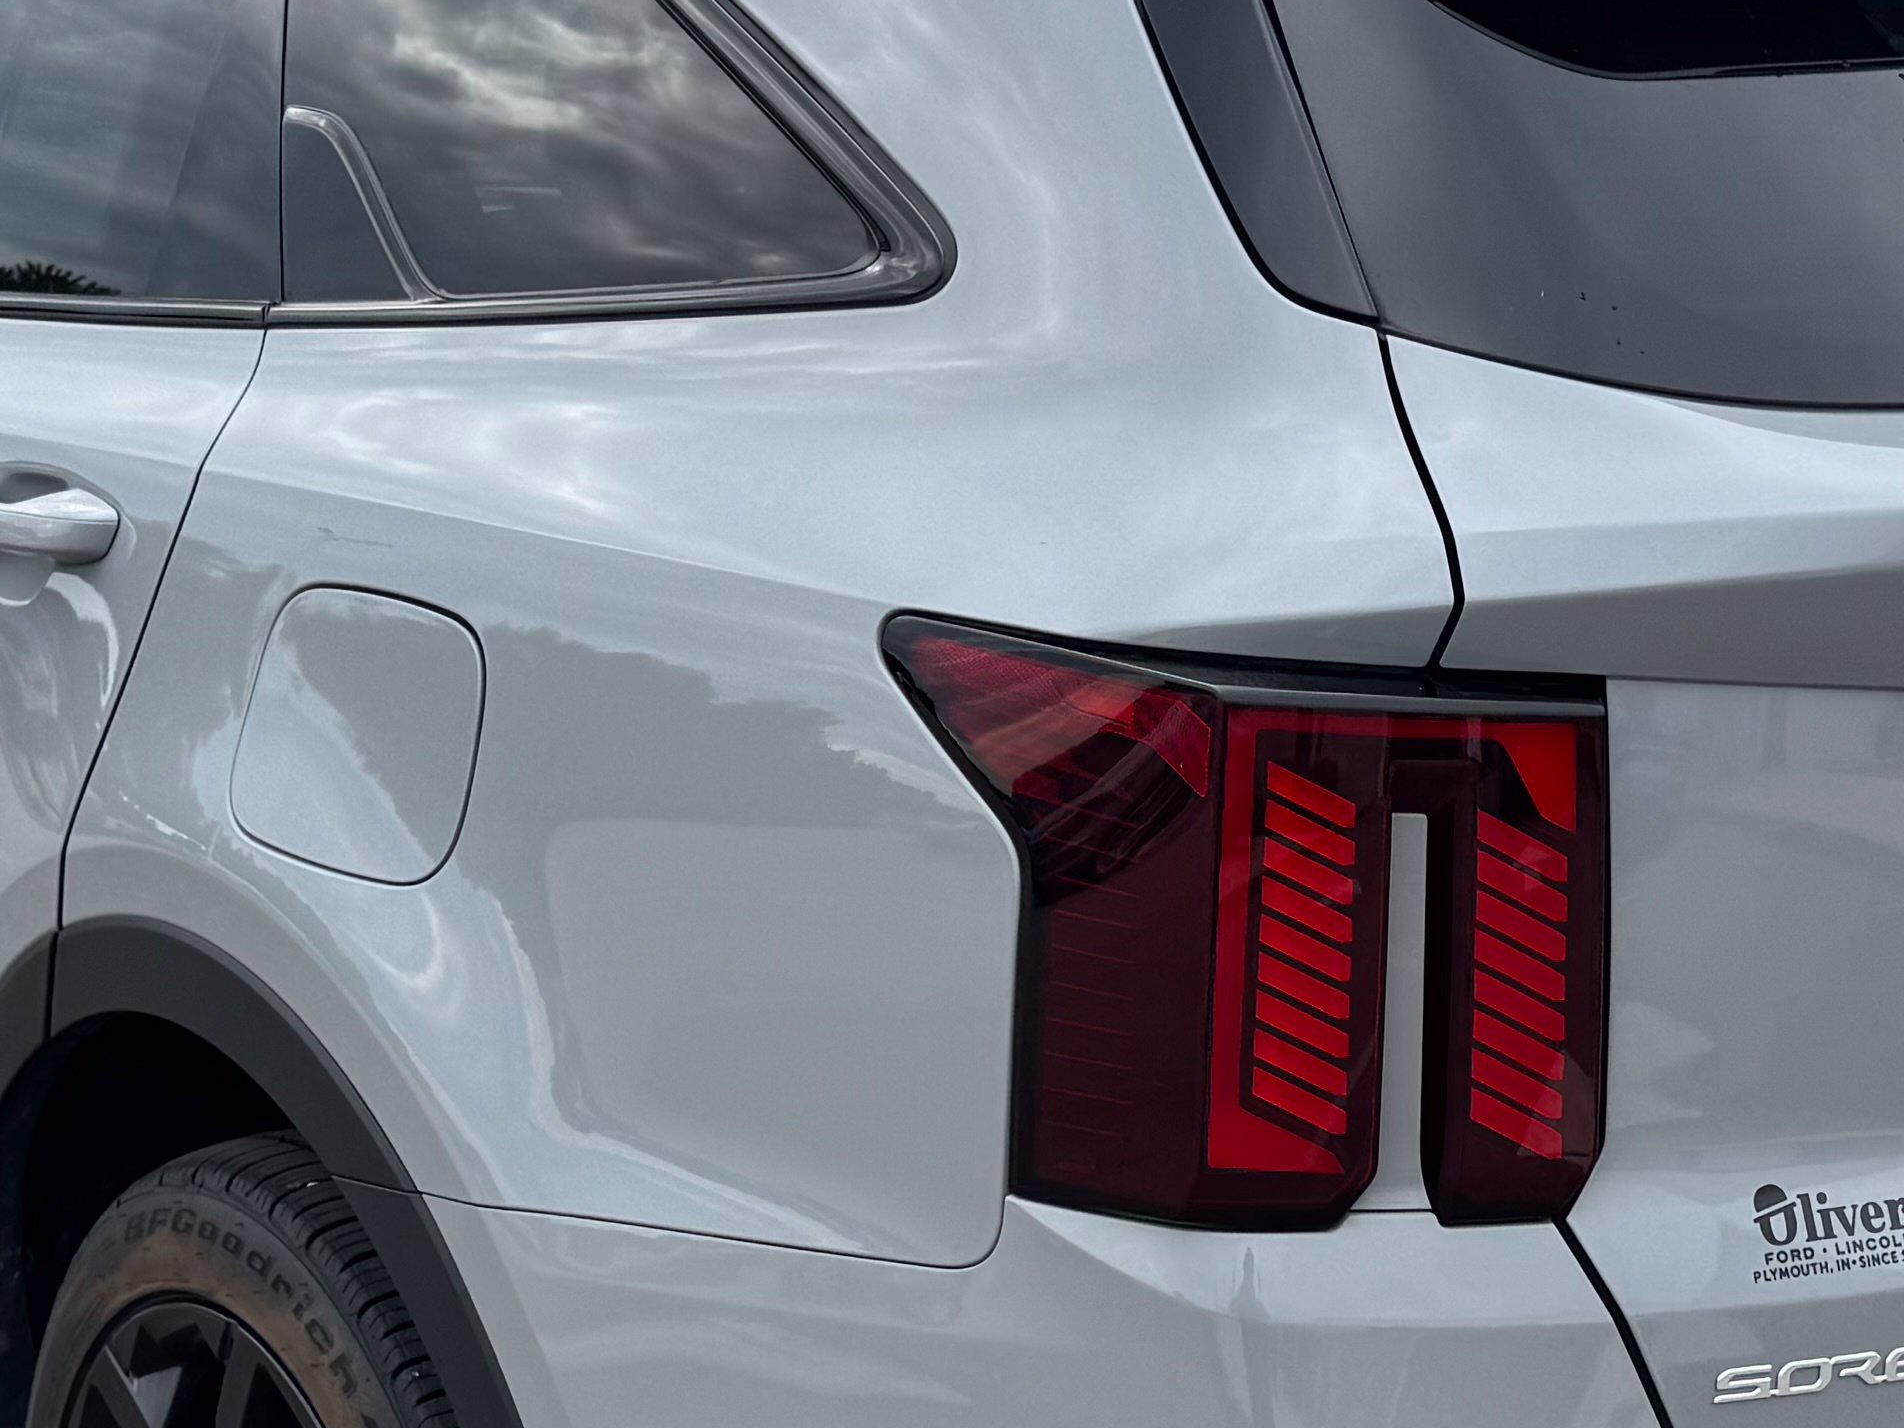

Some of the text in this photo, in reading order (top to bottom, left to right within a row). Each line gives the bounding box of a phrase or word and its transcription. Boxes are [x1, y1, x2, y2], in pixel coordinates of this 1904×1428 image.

[1764, 1247, 1816, 1266] FORD
[1753, 1261, 1834, 1284] PLYMOUTH,
[123, 1208, 358, 1400] BFGoodrich
